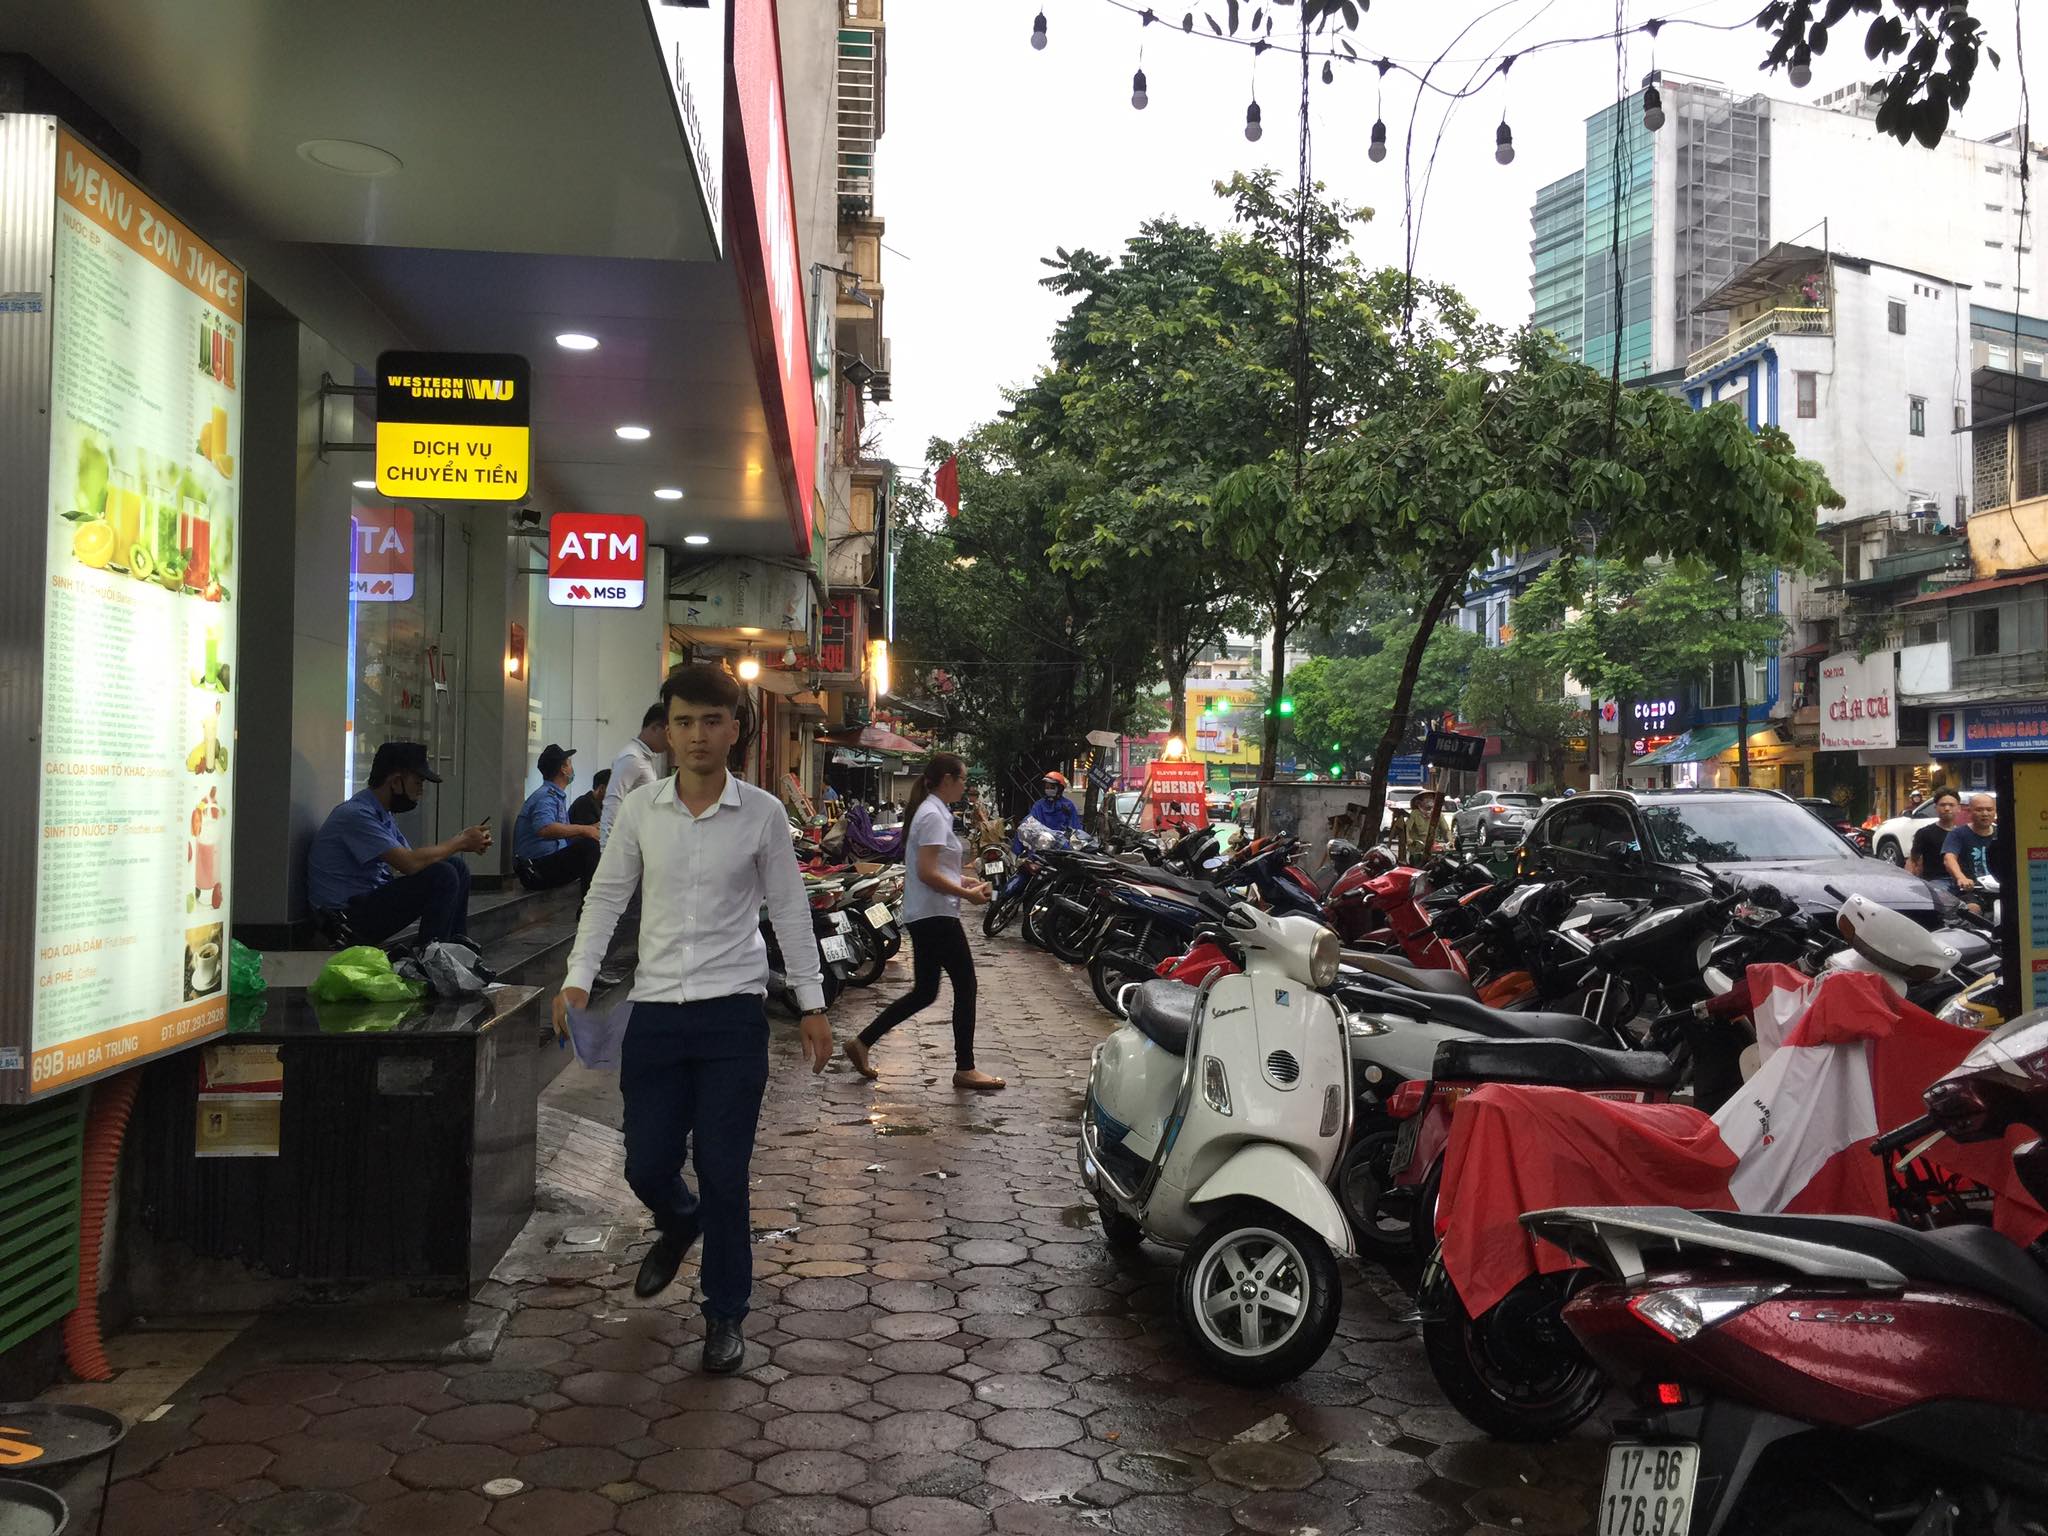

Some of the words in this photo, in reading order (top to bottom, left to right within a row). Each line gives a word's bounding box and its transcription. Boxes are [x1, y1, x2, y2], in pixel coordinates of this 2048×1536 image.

[64, 150, 133, 231] MENU
[138, 207, 182, 268] ZON
[186, 246, 239, 307] JUICE
[388, 375, 464, 389] WESTERN
[411, 387, 464, 399] UNION
[471, 379, 514, 400] WU
[413, 440, 459, 458] DỊCH
[466, 442, 492, 460] VỤ
[386, 460, 467, 482] CHUYỂN
[474, 463, 518, 484] TIỀN
[558, 531, 637, 561] ATM
[594, 586, 626, 599] MSB
[90, 764, 109, 776] SINH
[1153, 780, 1205, 794] CHERRY
[43, 826, 66, 839] SINH
[32, 1050, 65, 1083] 69B
[67, 1054, 85, 1071] HAI
[88, 1045, 103, 1065] BÀ
[1620, 1450, 1683, 1491] 17-B6
[1606, 1494, 1686, 1536] 176.92
